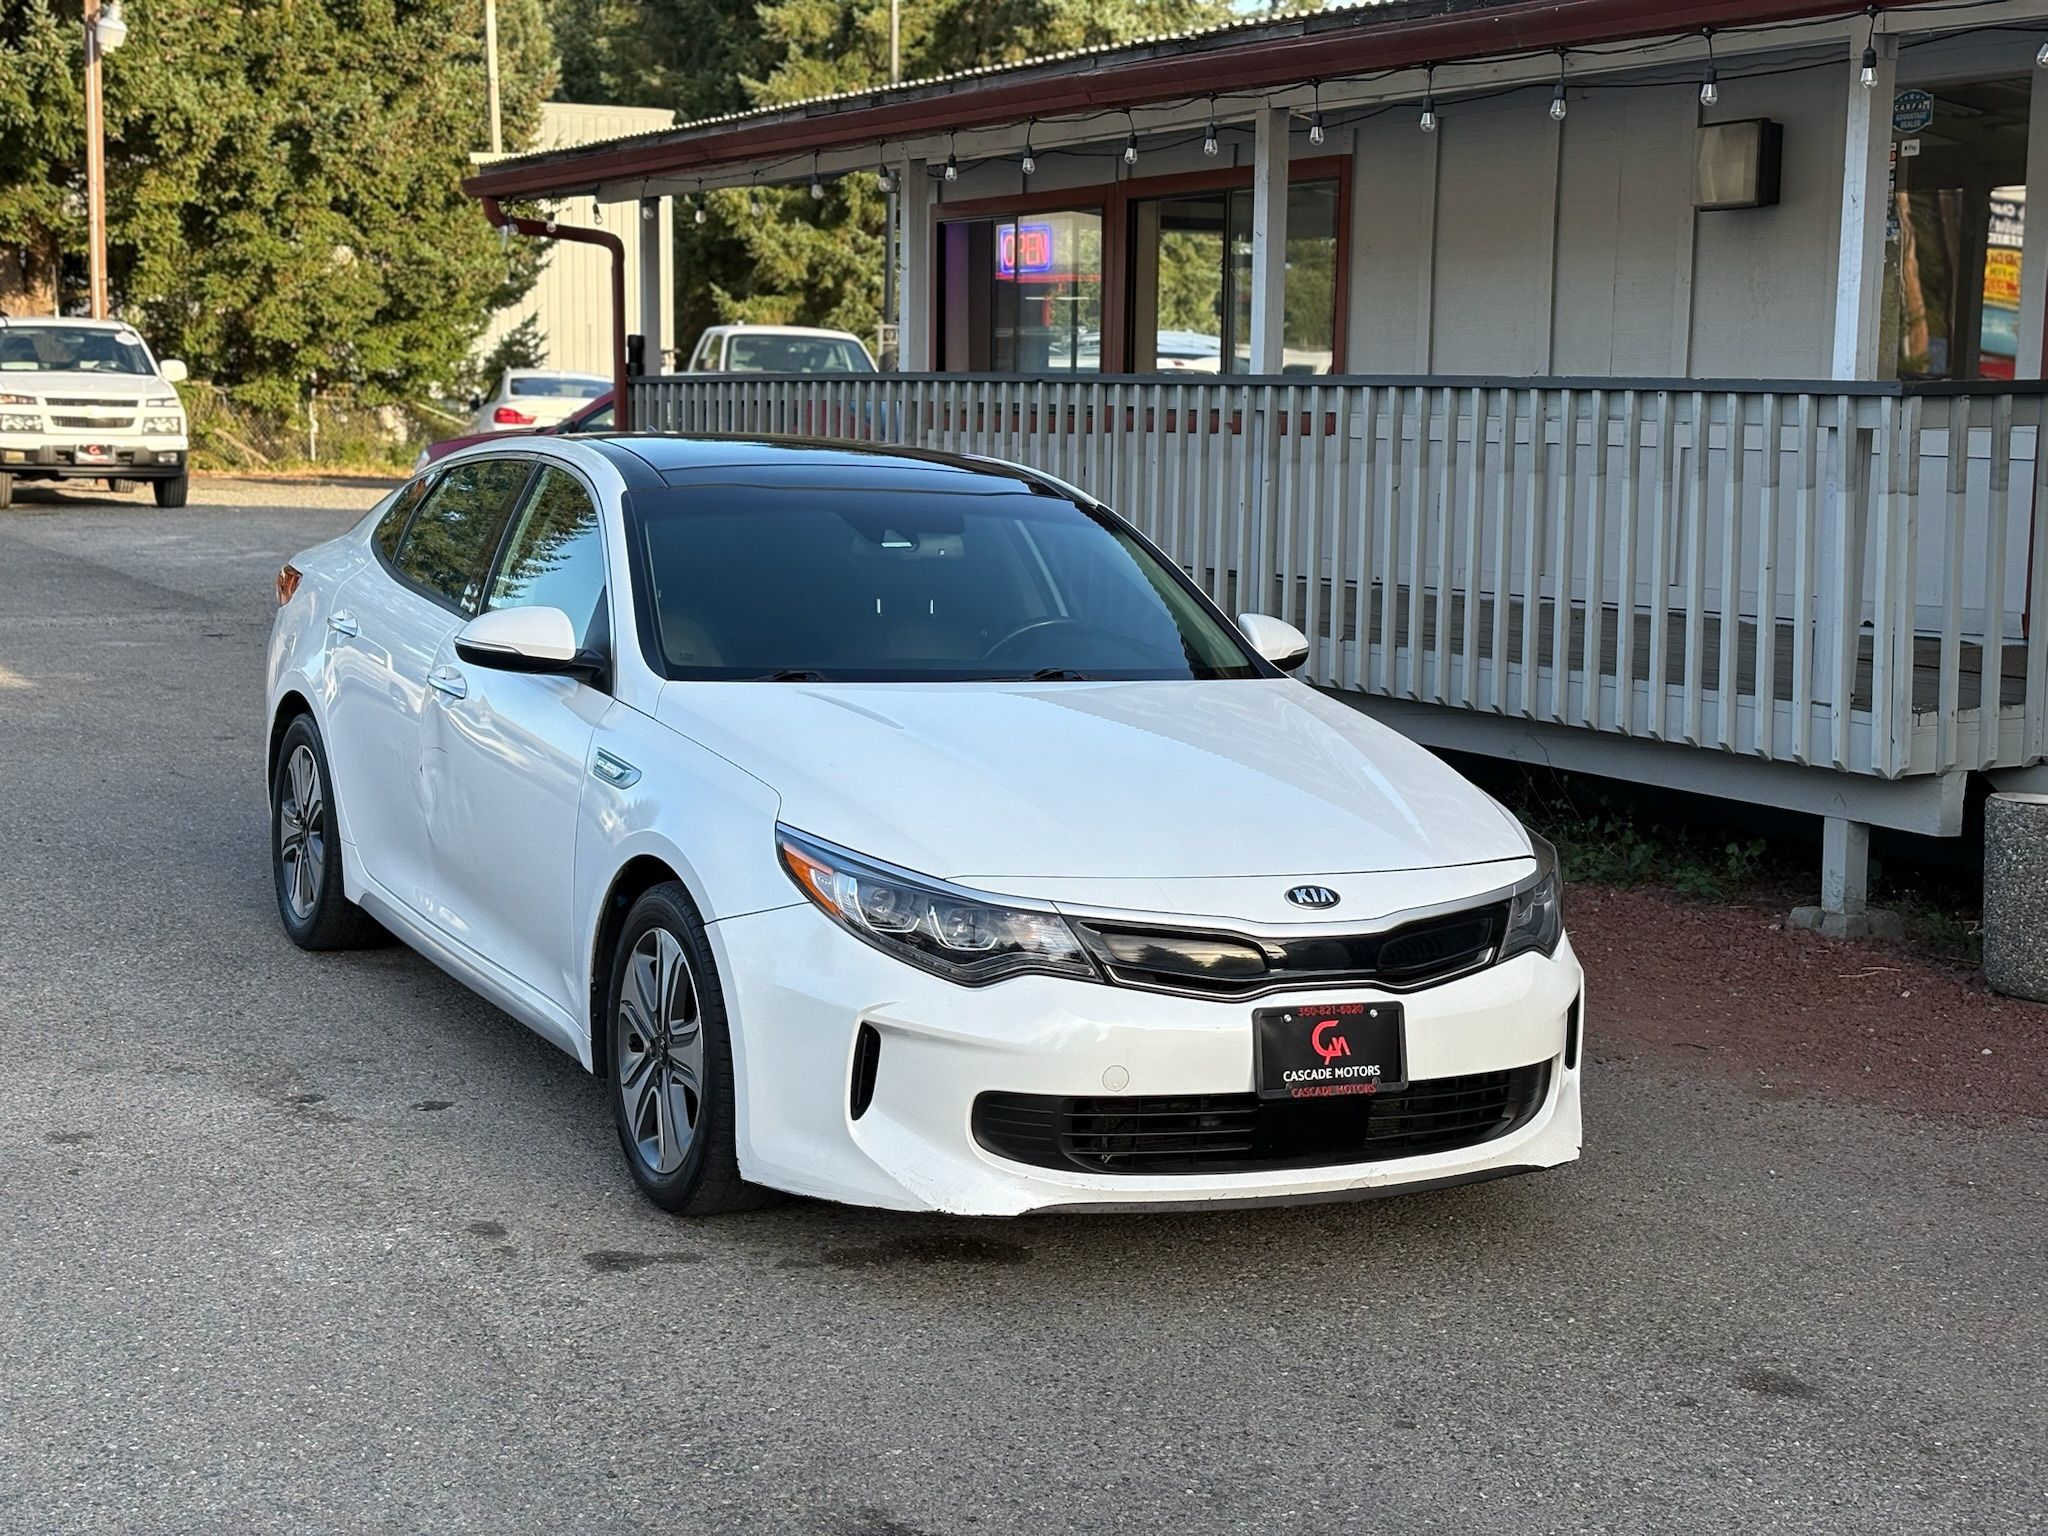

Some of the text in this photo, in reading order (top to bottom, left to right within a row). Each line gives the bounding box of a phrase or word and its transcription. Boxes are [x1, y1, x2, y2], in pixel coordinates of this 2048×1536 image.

[1293, 888, 1334, 903] KIA
[1283, 1065, 1381, 1082] CASCADE MOTORS
[1291, 1084, 1377, 1098] CASCADE MOTORS
